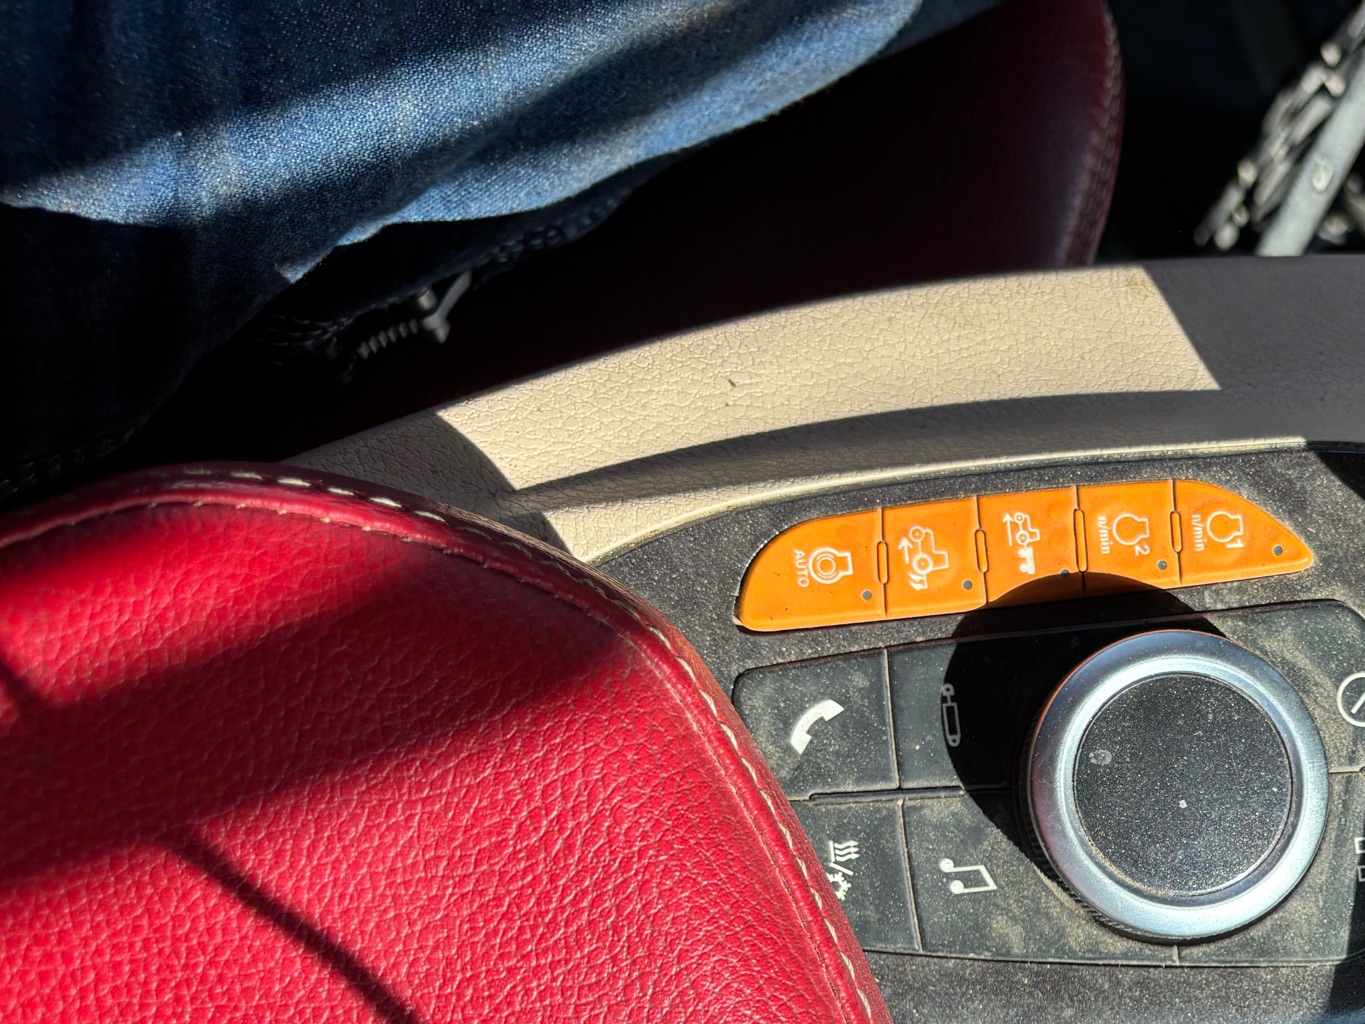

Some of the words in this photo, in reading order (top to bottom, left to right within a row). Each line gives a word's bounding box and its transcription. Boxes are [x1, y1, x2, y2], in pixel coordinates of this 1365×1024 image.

[1097, 516, 1113, 555] n/min
[1135, 545, 1150, 556] 2
[1191, 514, 1207, 551] n/min
[1226, 538, 1244, 549] 1
[793, 548, 810, 588] AUTO
